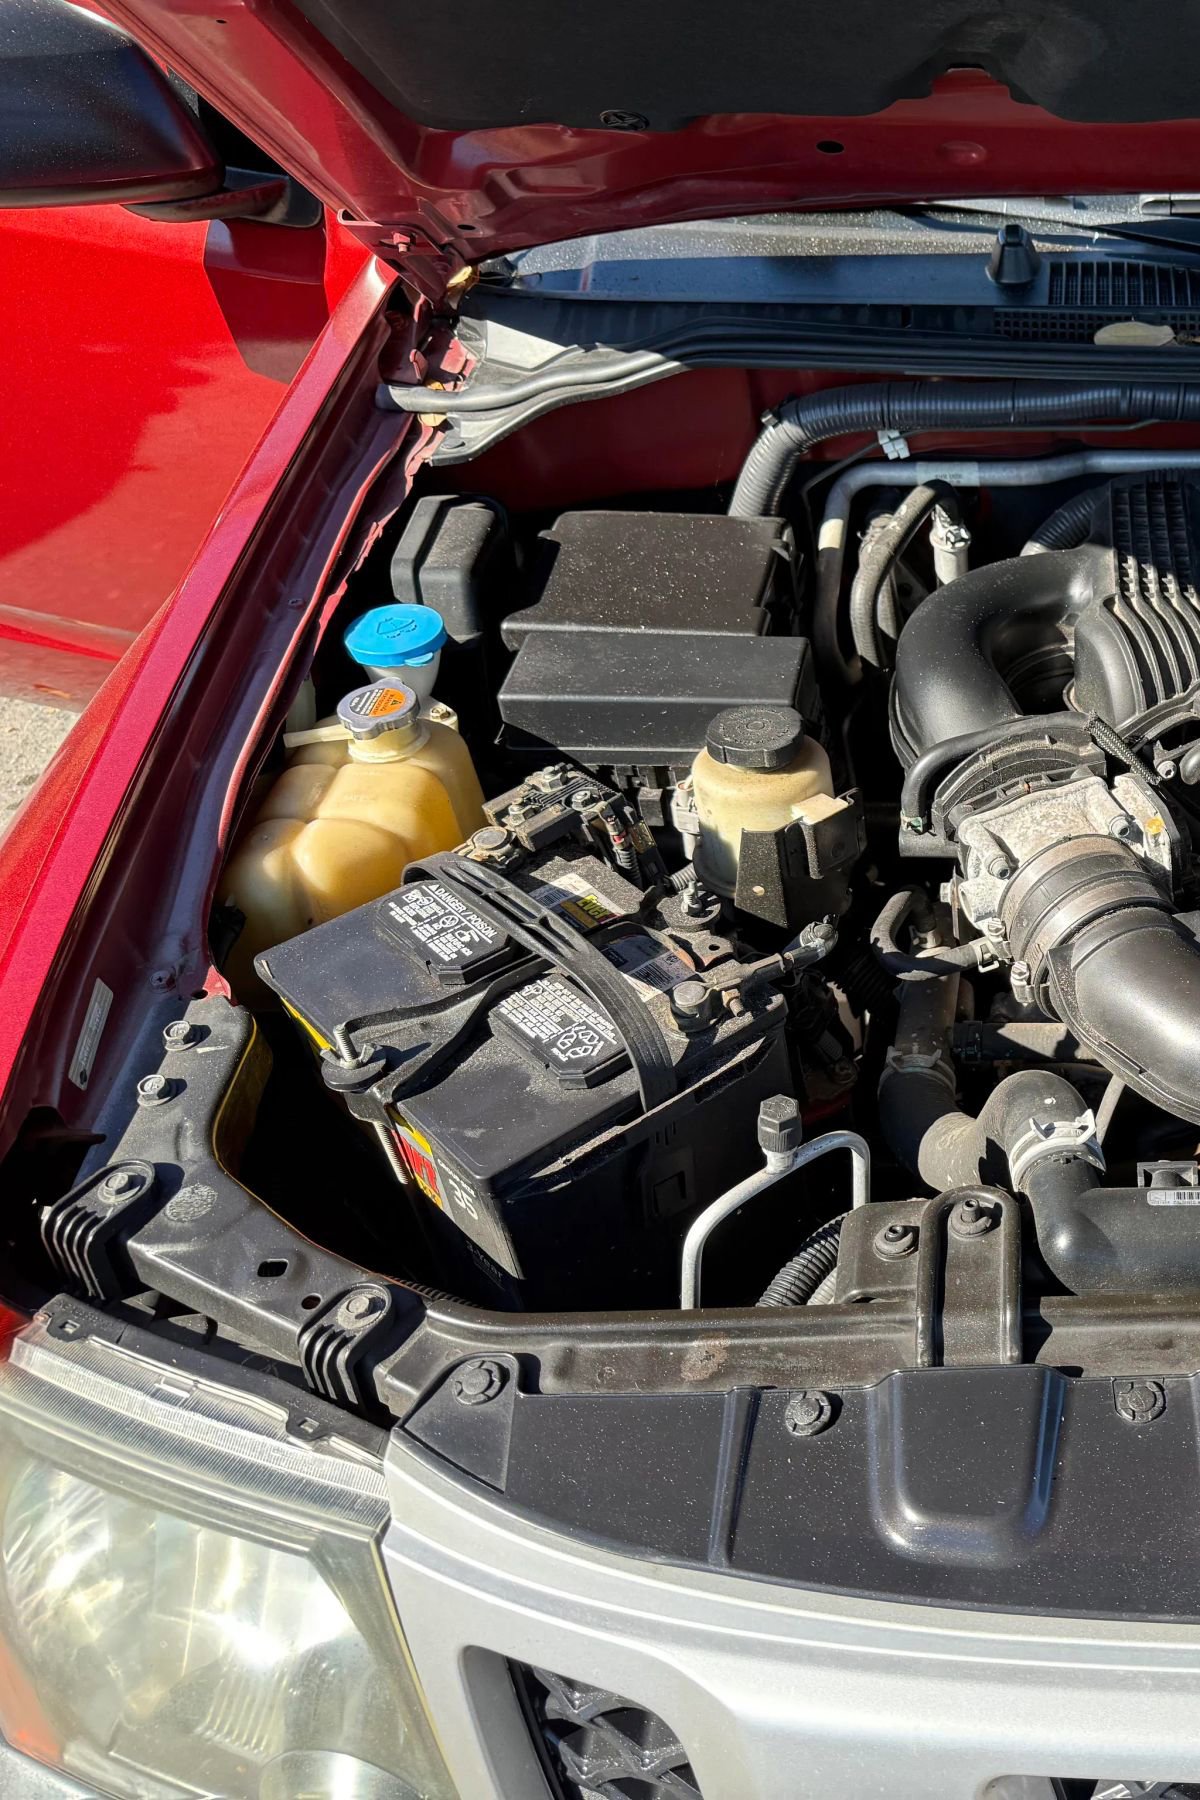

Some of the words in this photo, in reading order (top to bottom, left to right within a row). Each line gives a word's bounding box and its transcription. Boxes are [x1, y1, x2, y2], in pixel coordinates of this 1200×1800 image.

[434, 887, 468, 913] DANGER
[466, 914, 498, 938] POISON
[448, 1178, 478, 1220] 35
